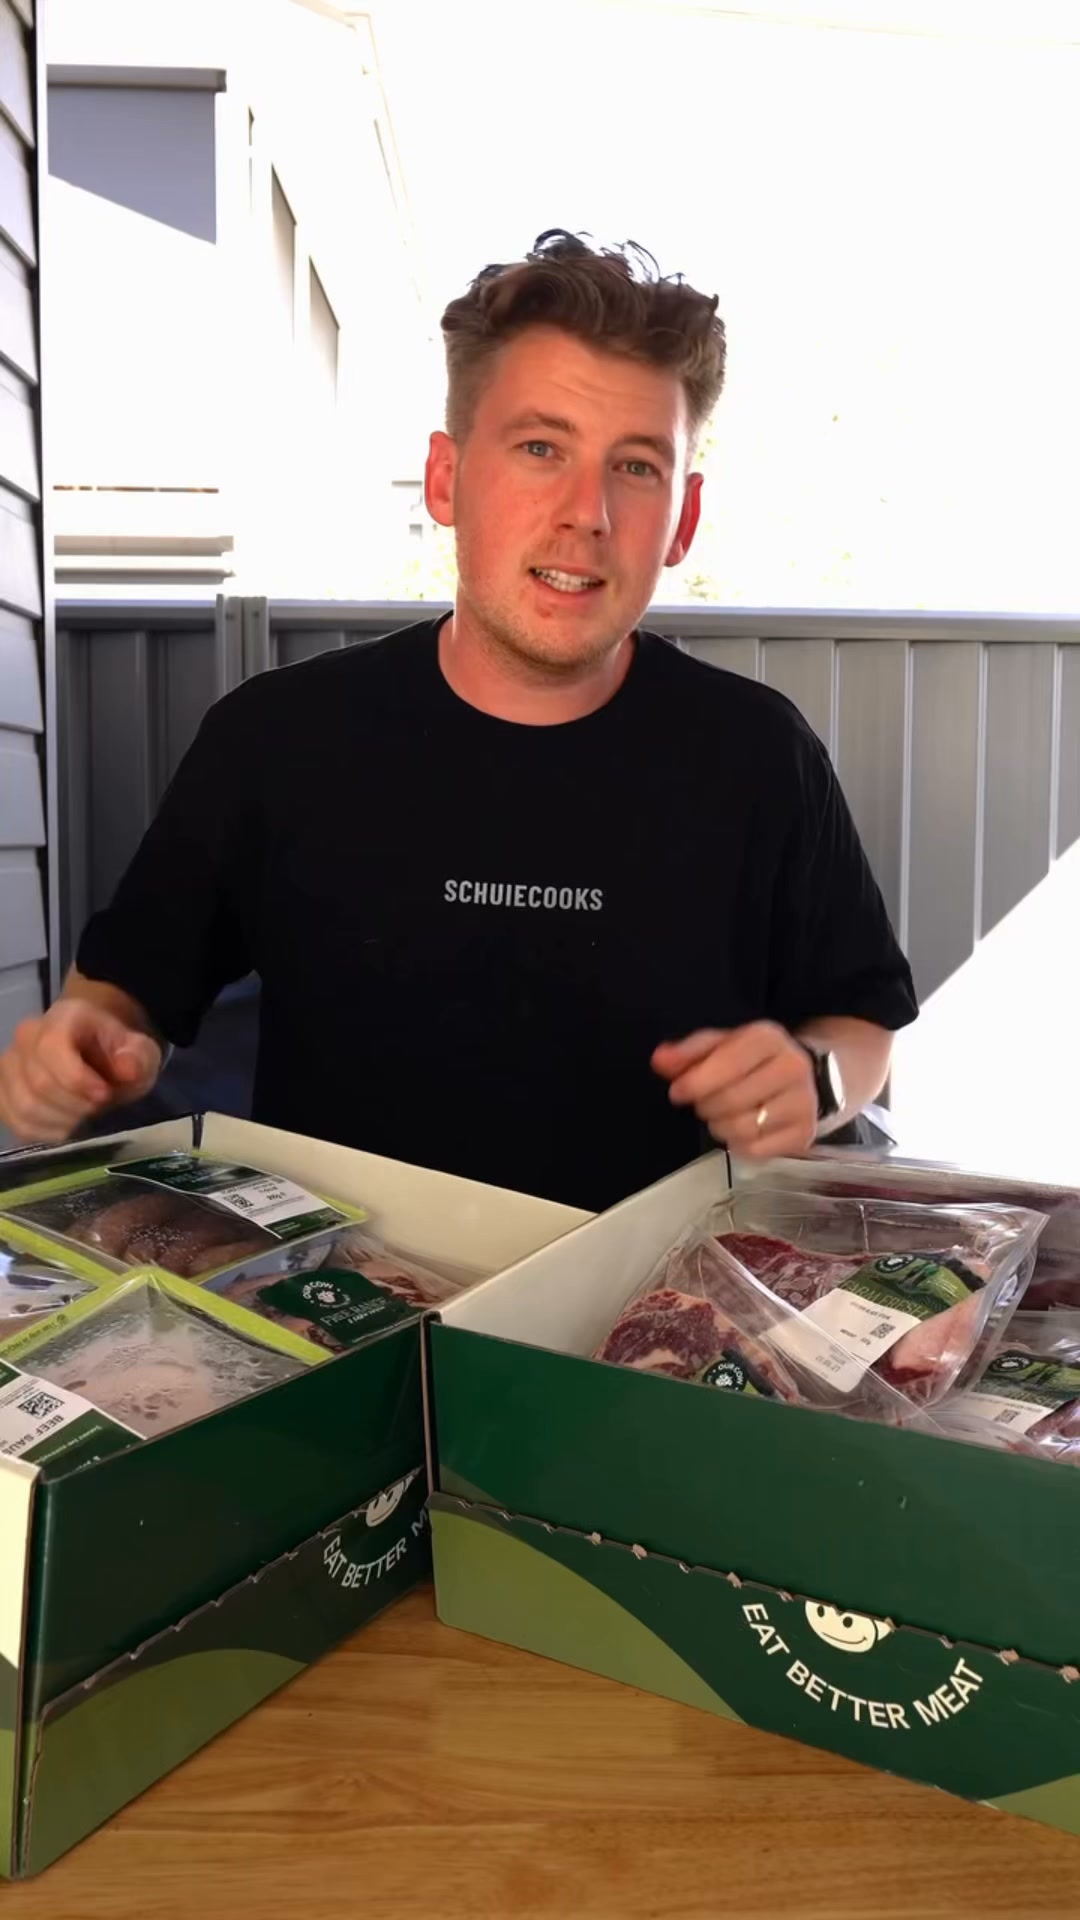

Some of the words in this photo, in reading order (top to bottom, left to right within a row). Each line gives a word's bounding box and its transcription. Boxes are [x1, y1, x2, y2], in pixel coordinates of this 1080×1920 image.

[444, 879, 603, 911] SCHUIECOOKS
[878, 1294, 929, 1319] FRESH
[718, 1363, 735, 1371] OUR
[733, 1366, 744, 1385] COW
[36, 1415, 64, 1436] BEEF
[322, 1535, 348, 1579] EAT
[341, 1536, 408, 1589] BETTER
[741, 1602, 790, 1656] EAT
[785, 1659, 911, 1730] BETTER
[912, 1656, 984, 1727] MEAT
